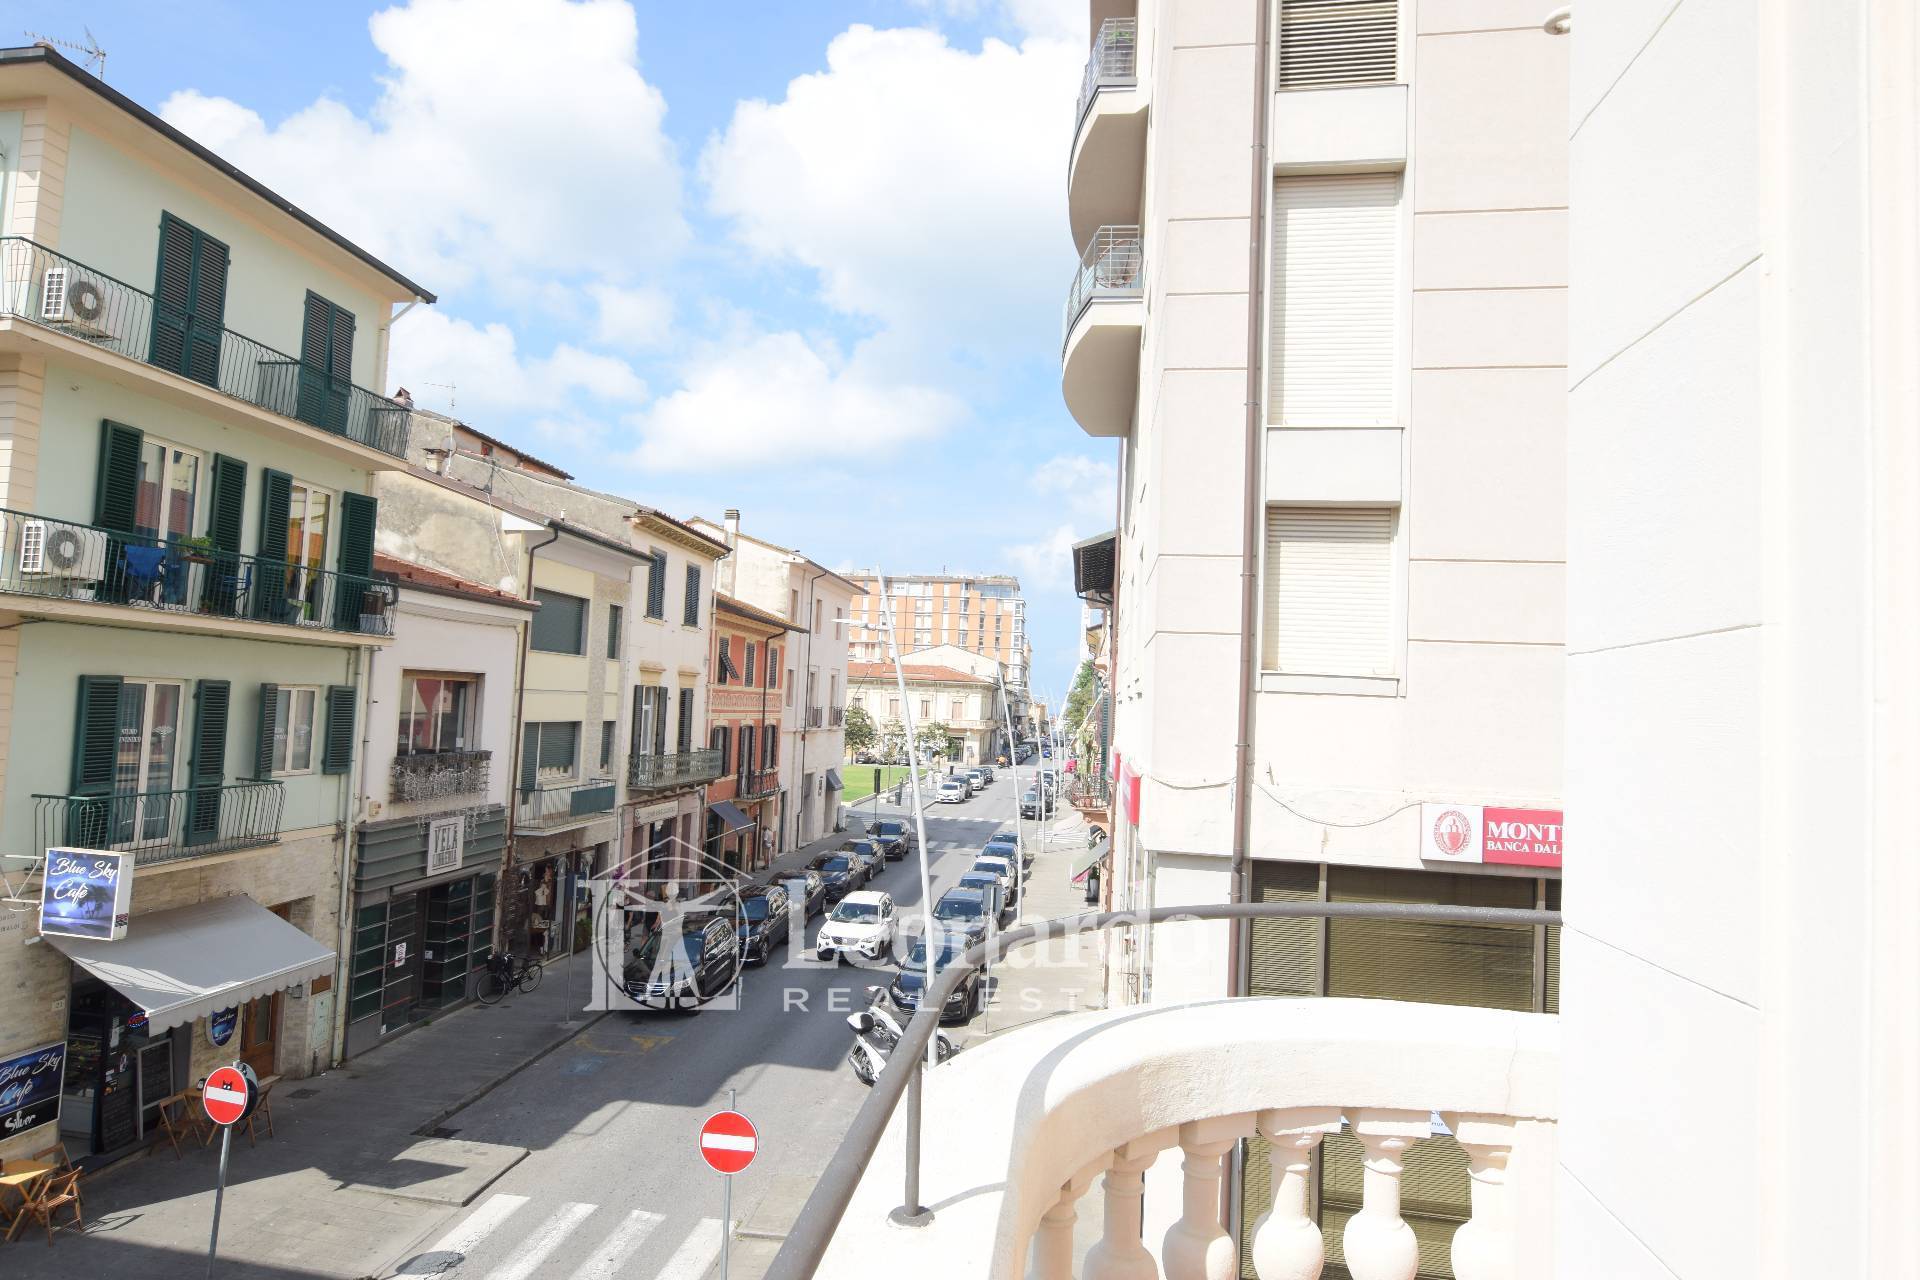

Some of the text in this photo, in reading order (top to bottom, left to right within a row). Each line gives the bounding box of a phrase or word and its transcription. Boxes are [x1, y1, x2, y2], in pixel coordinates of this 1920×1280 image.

[1487, 840, 1561, 854] BANCA DAL
[50, 857, 117, 884] Blue Sky
[0, 1052, 62, 1086] Blue Sky
